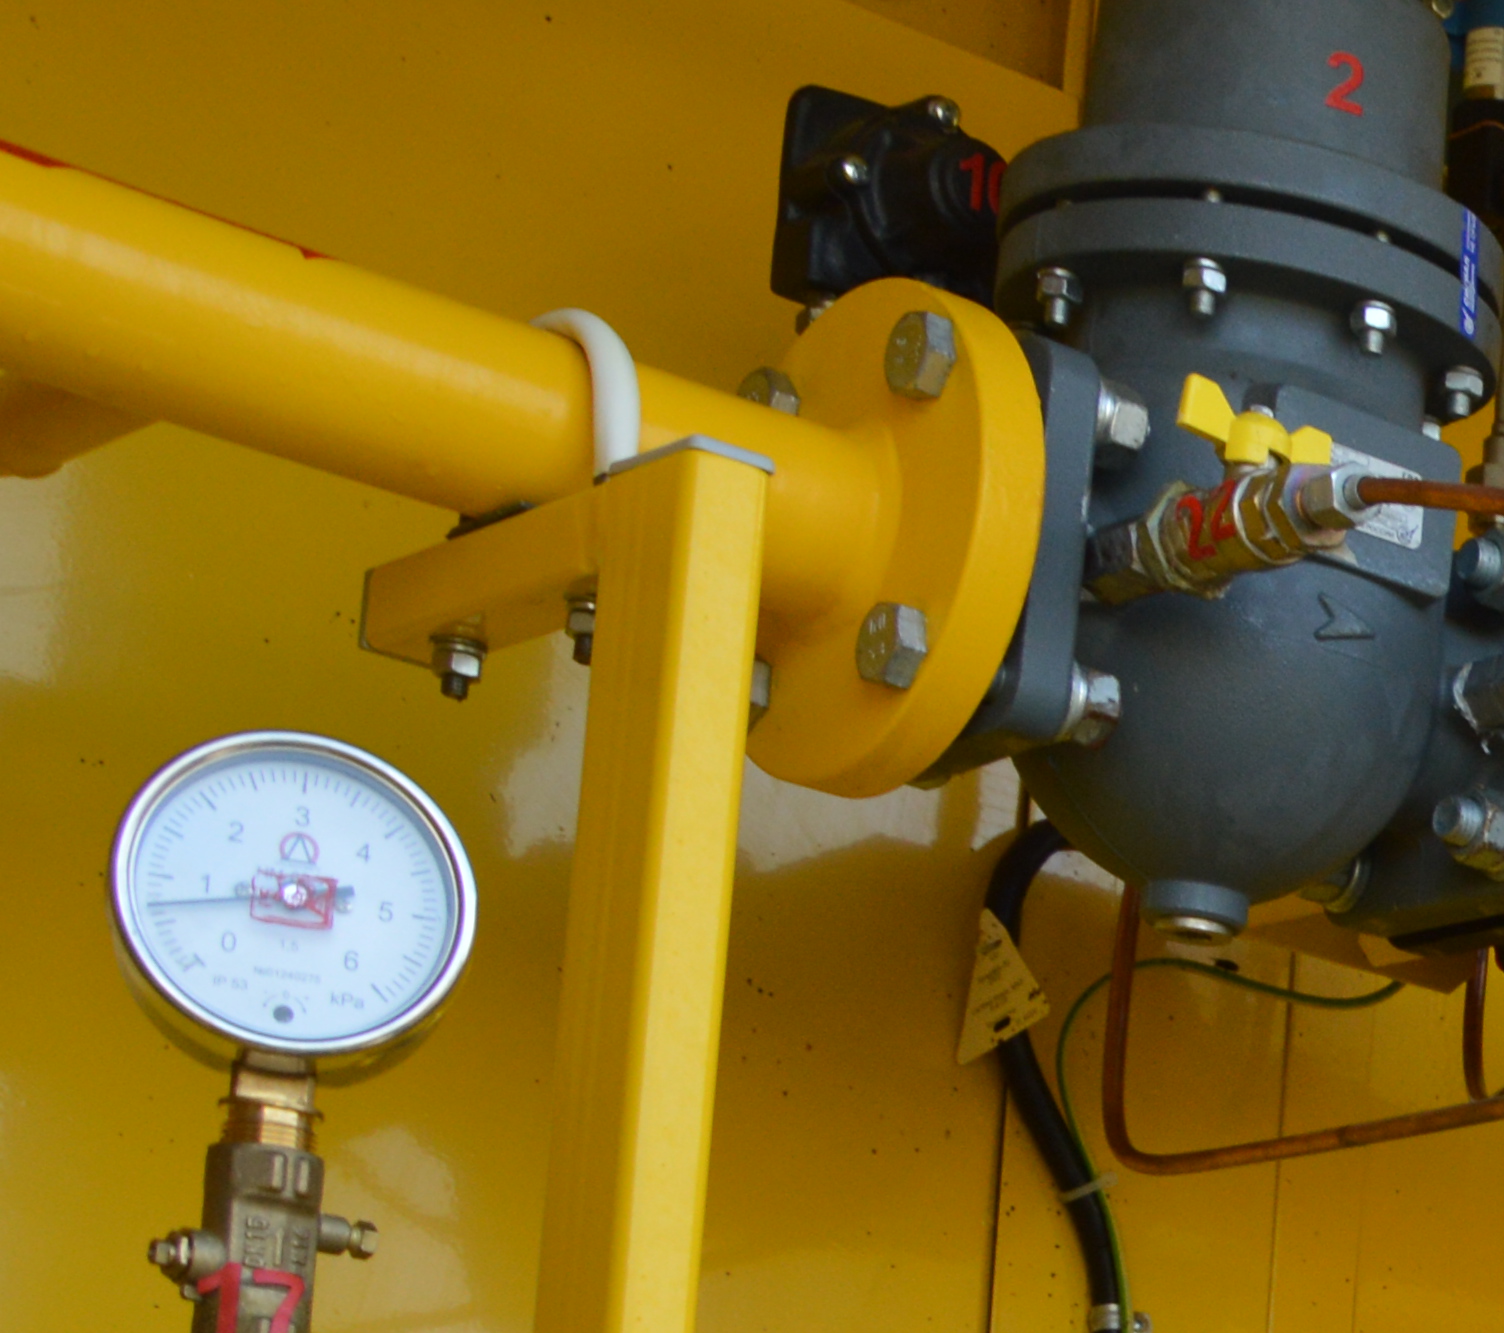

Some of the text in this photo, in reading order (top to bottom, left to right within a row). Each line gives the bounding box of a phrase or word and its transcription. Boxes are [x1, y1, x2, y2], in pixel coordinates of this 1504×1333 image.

[1324, 50, 1364, 117] 2
[295, 806, 310, 827] 3
[228, 821, 244, 843] 2
[356, 843, 371, 863] 4
[202, 873, 211, 894] 1
[378, 901, 393, 923] 5
[221, 931, 237, 952] 0
[344, 950, 360, 972] 6
[330, 991, 365, 1010] kPa
